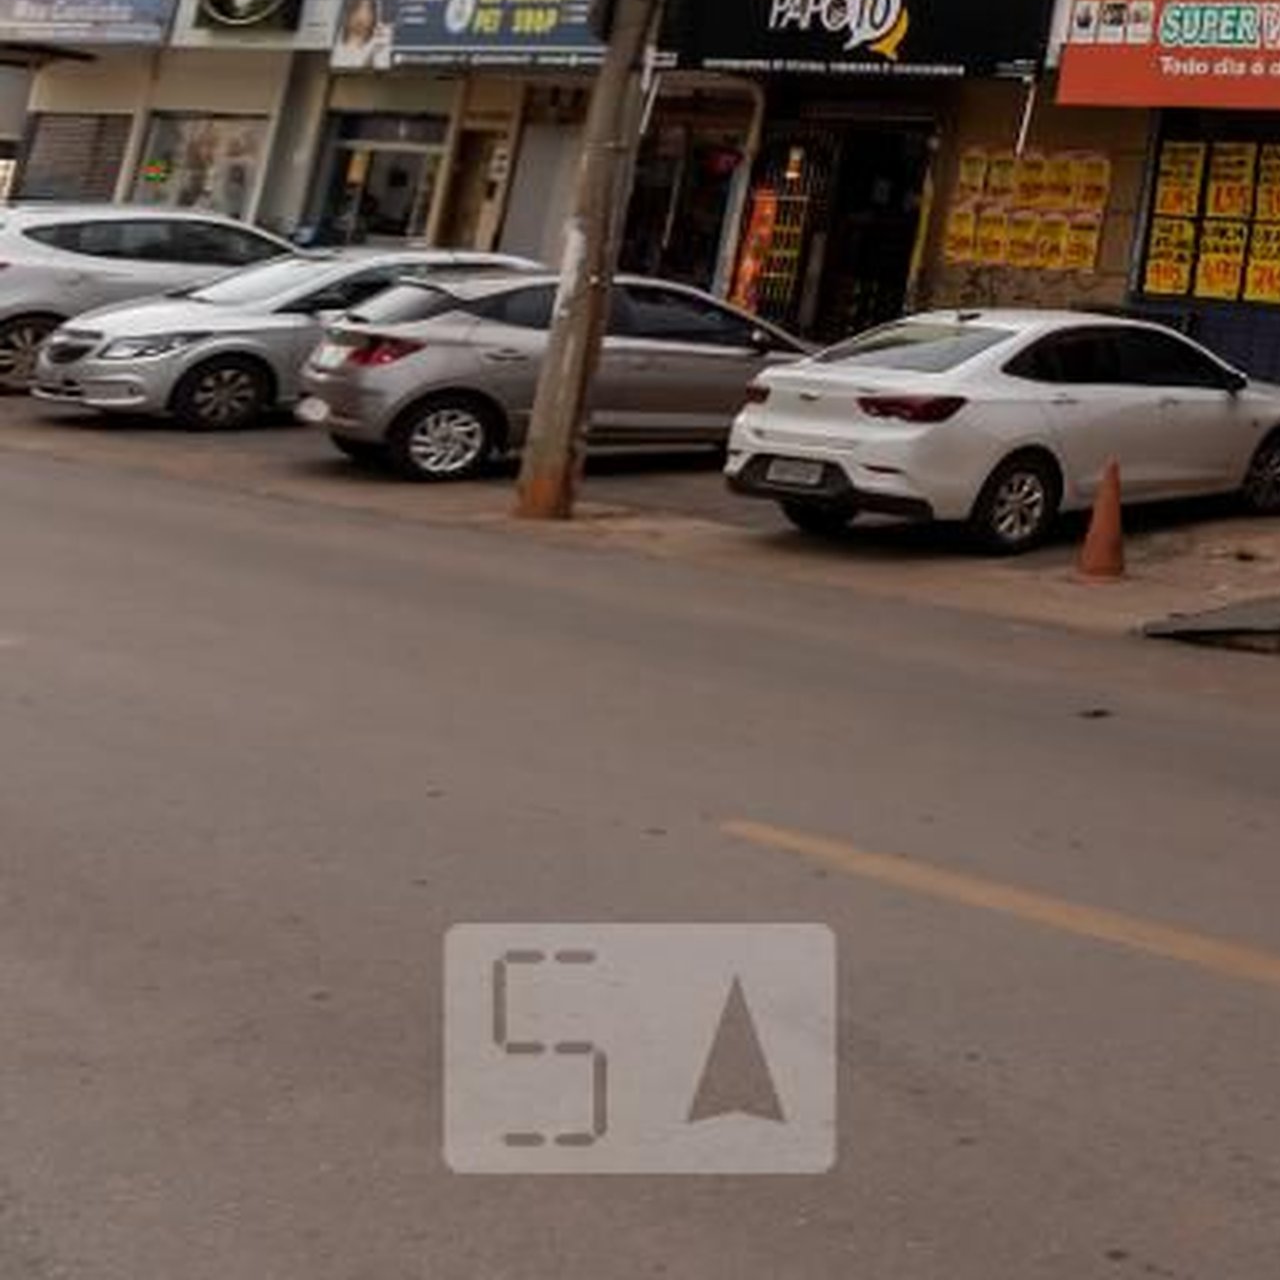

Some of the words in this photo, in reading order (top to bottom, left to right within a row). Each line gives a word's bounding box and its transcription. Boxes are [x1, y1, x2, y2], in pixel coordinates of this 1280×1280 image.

[1161, 3, 1259, 46] SUPER
[1160, 55, 1210, 76] Todo
[1214, 57, 1246, 76] dia
